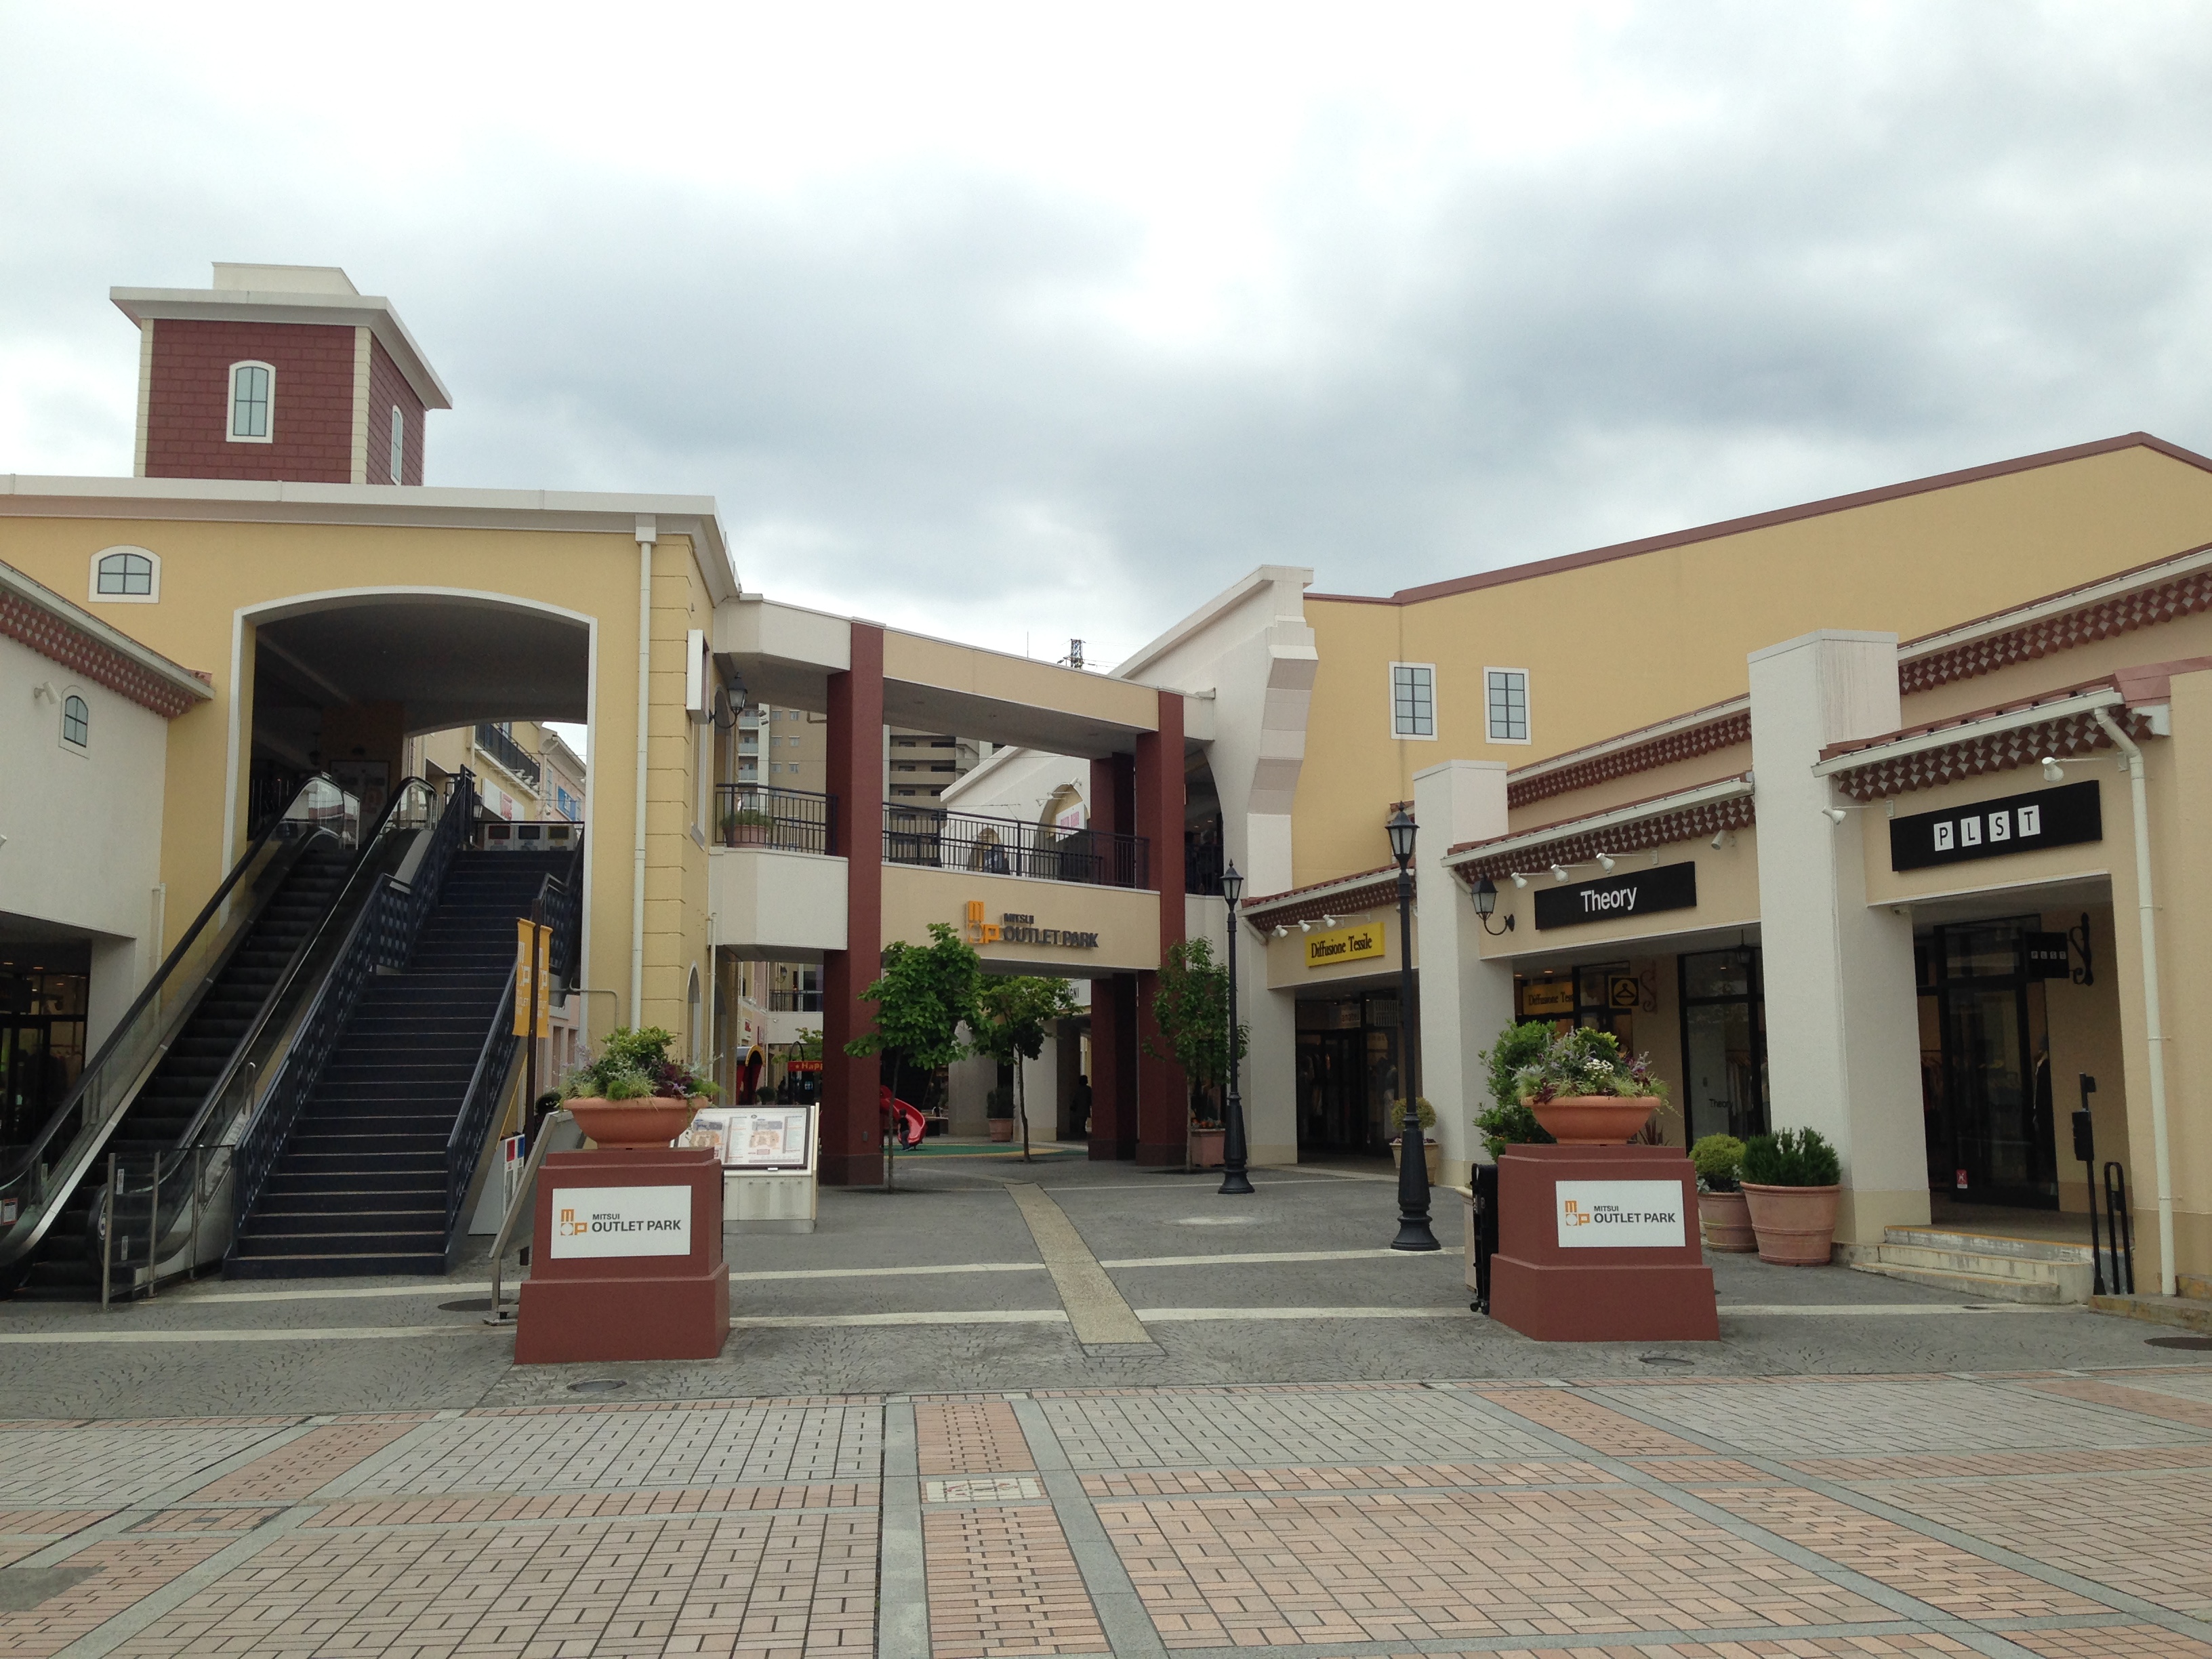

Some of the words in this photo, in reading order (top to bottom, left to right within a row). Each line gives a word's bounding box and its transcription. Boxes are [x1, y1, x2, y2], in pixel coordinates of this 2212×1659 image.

[1939, 811, 2034, 846] PLST
[1580, 886, 1637, 912] Theory
[1004, 913, 1035, 924] MITSUI
[1003, 925, 1060, 945] OUTLET
[1062, 930, 1099, 948] PARK
[1311, 939, 1347, 958] Diffusione
[1348, 933, 1373, 951] Tessile
[1708, 1099, 1734, 1109] Theory
[592, 1221, 644, 1232] OUTLET
[647, 1219, 681, 1231] PARK
[1594, 1212, 1641, 1223] OUTLET
[1644, 1212, 1676, 1223] PARK
